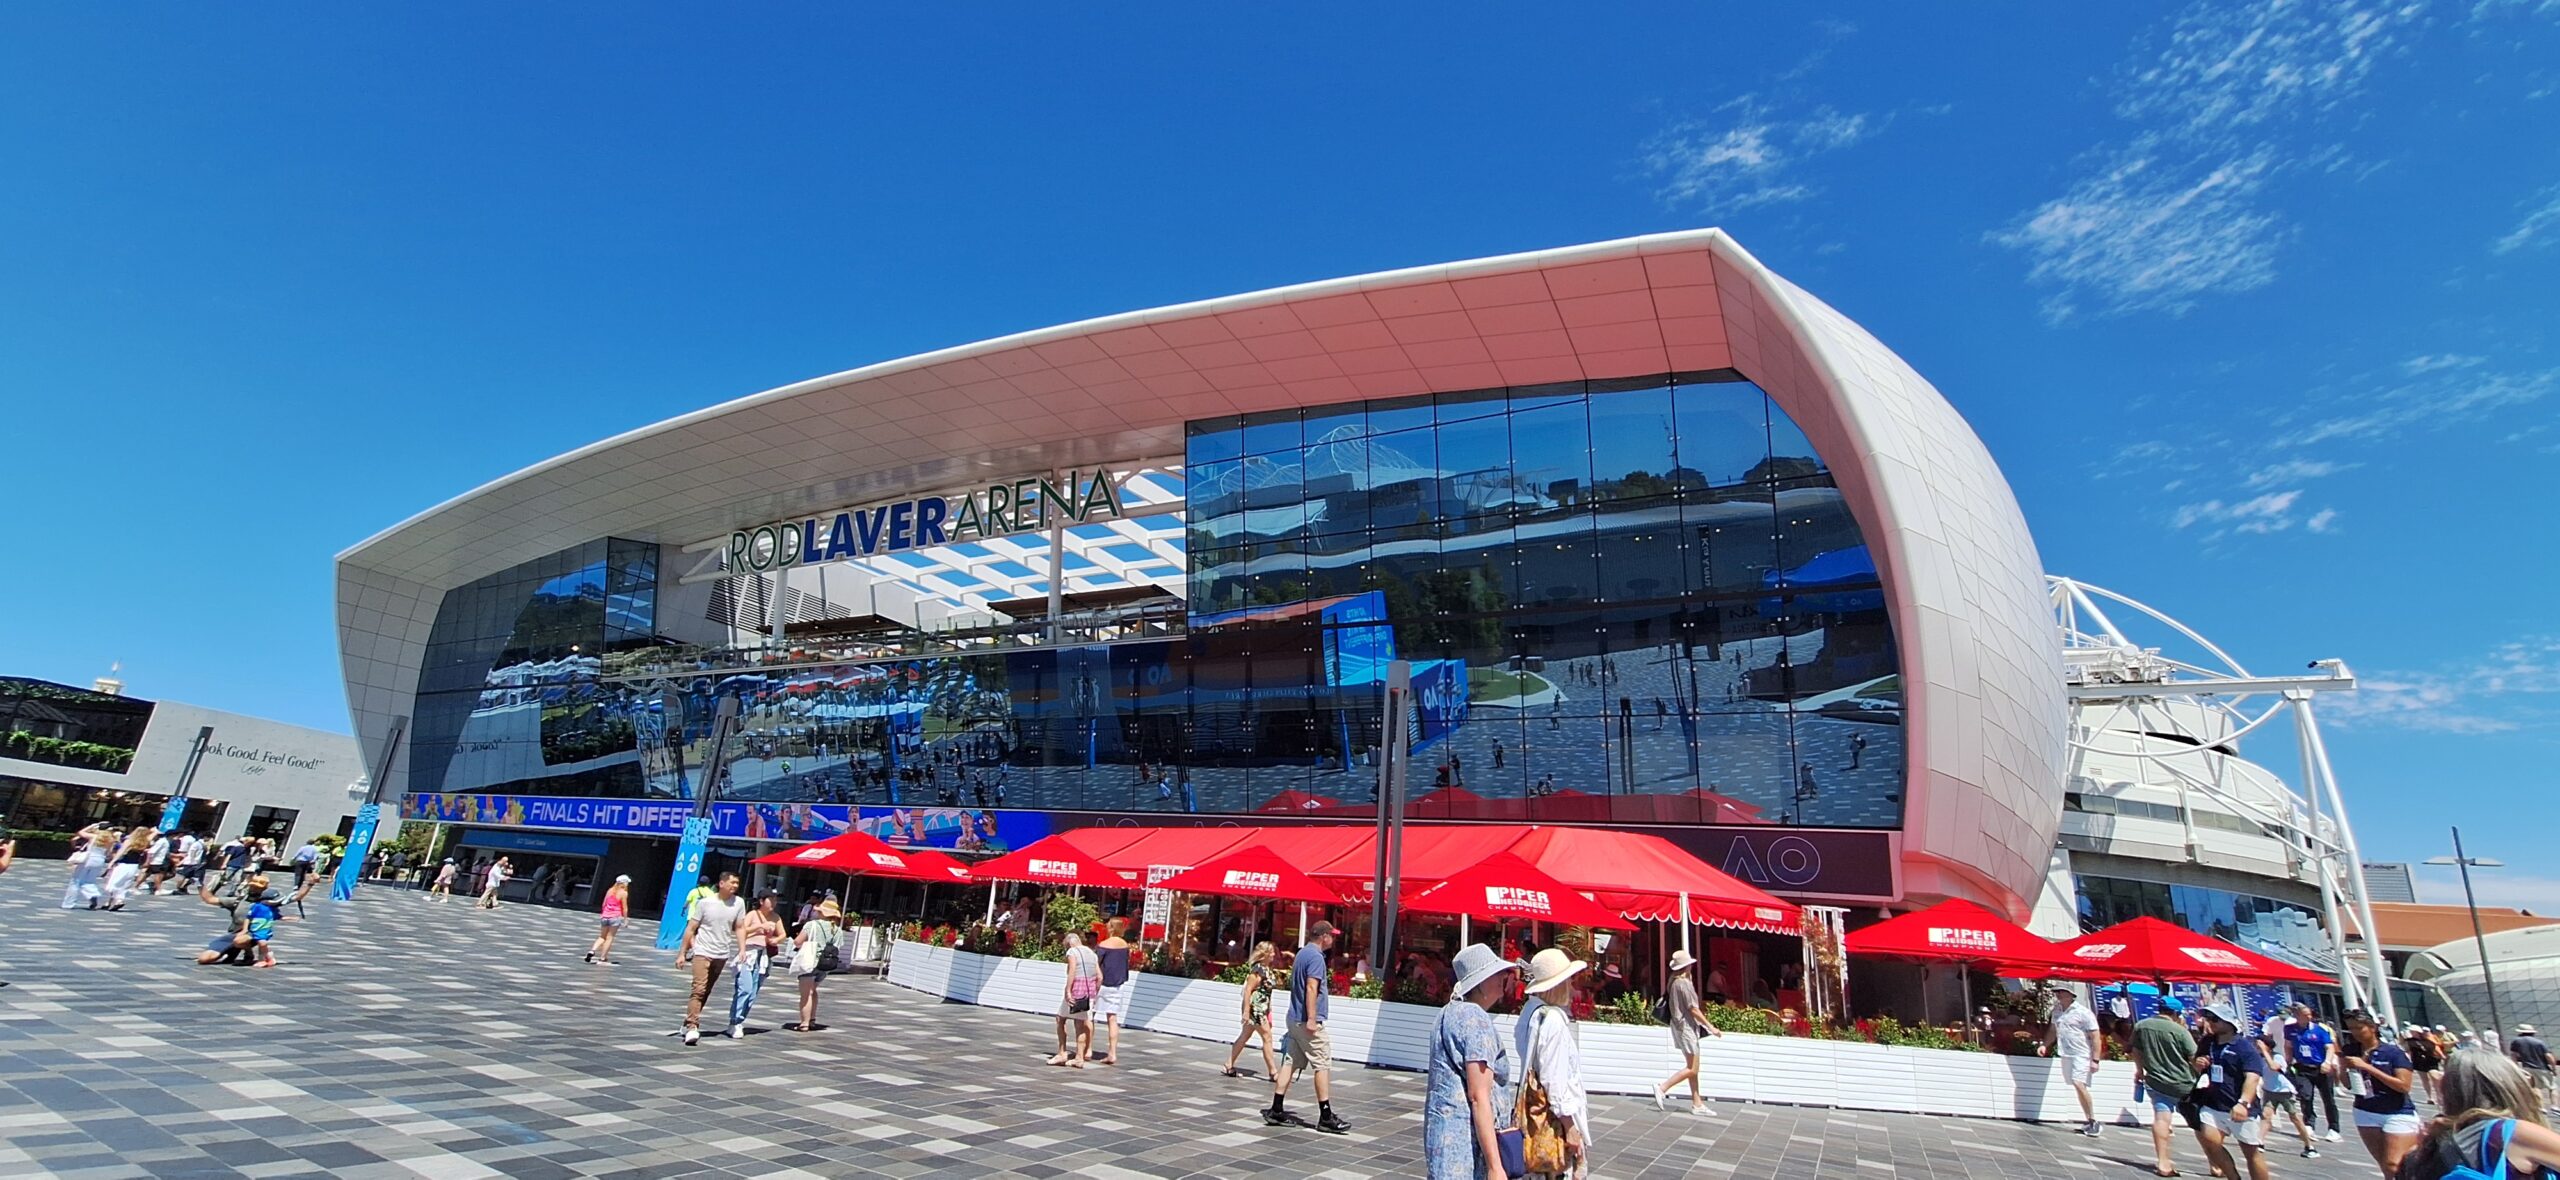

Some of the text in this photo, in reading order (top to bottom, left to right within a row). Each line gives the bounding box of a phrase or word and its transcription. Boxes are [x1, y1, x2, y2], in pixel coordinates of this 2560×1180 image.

[729, 466, 1120, 575] ROD LAVER ARENA
[261, 751, 286, 765] Feel
[530, 801, 736, 831] FINALS HIT DIFFENT
[1039, 860, 1078, 870] PIPER
[1721, 835, 1821, 885] AO
[1236, 871, 1280, 883] PIPER
[1499, 886, 1550, 903] PIPER
[1942, 927, 1997, 941] PIPER
